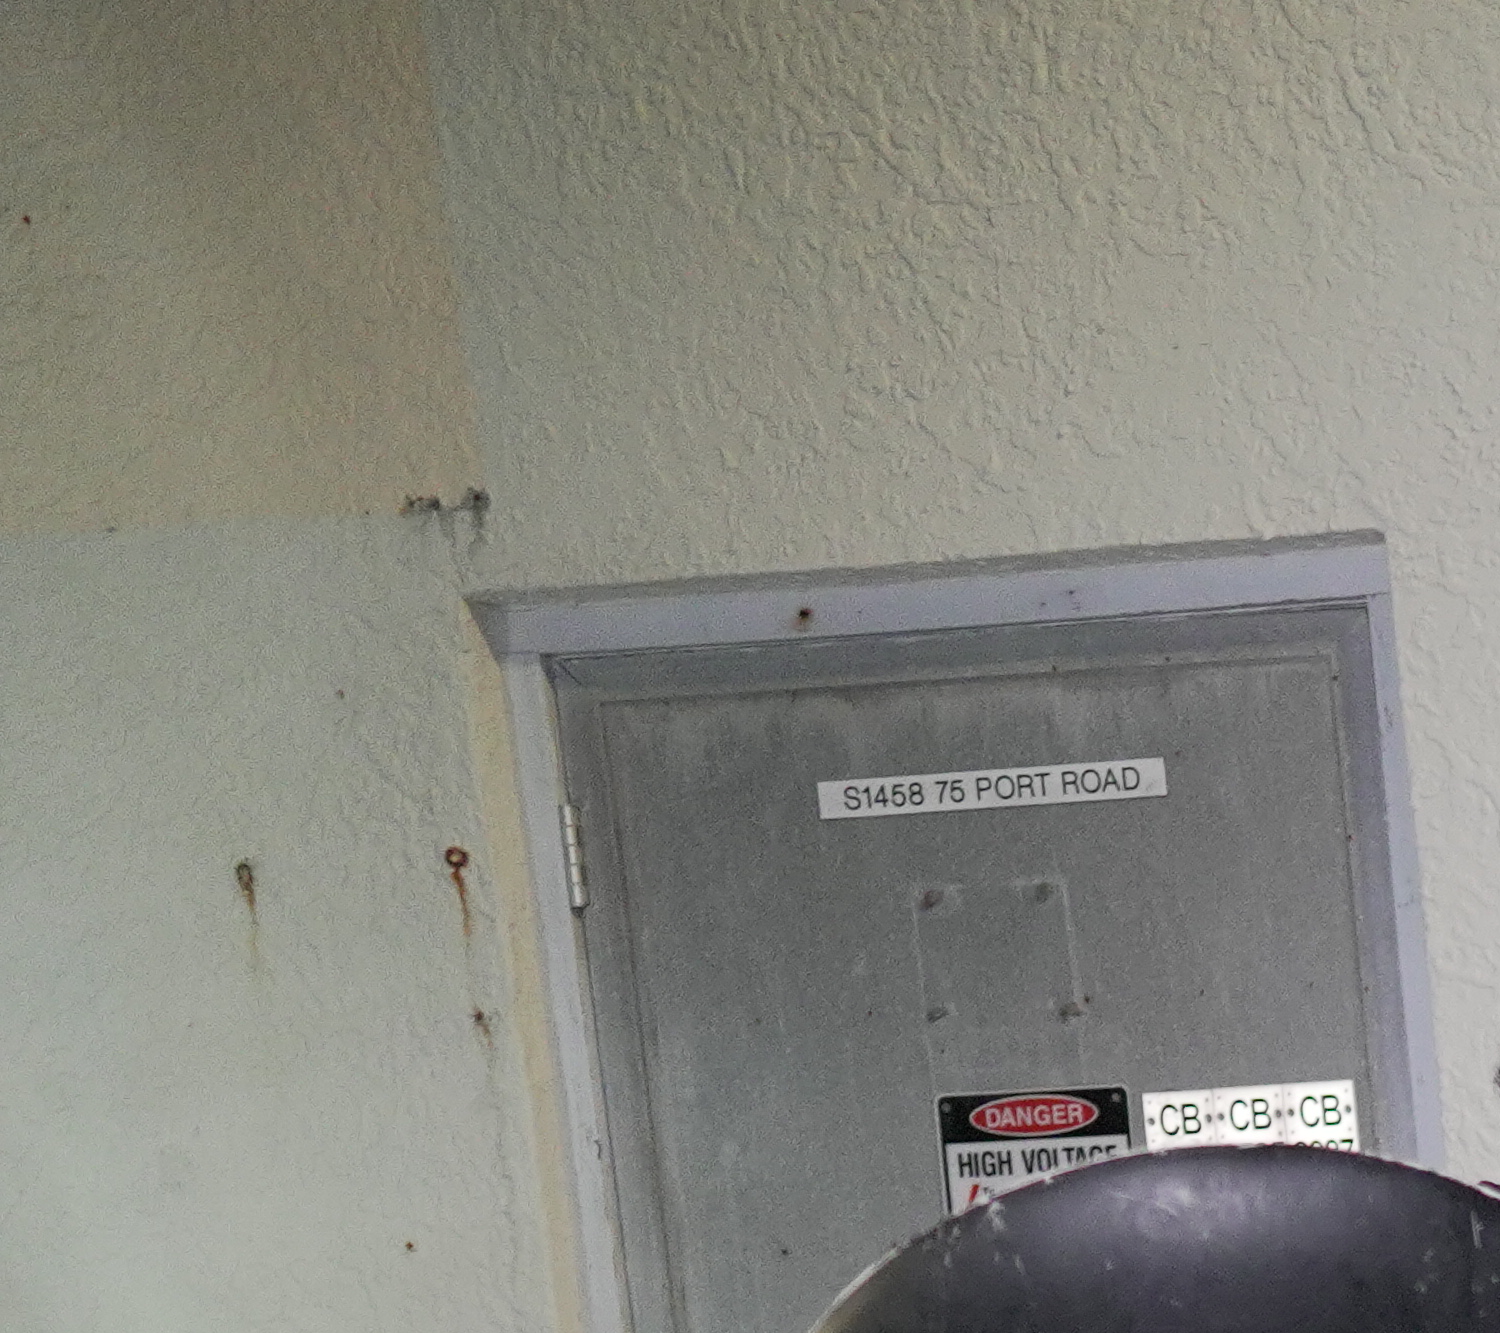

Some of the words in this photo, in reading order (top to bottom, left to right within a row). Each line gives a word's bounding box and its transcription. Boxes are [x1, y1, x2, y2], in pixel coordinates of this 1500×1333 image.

[843, 782, 924, 811] S1458
[936, 779, 965, 804] 75
[976, 773, 1051, 801] PORT
[1061, 767, 1141, 795] ROAD
[984, 1103, 1084, 1128] DANGER
[1160, 1103, 1202, 1136] CB
[1230, 1098, 1272, 1131] CB
[1300, 1094, 1342, 1127] CB
[957, 1150, 1013, 1178] HIGH
